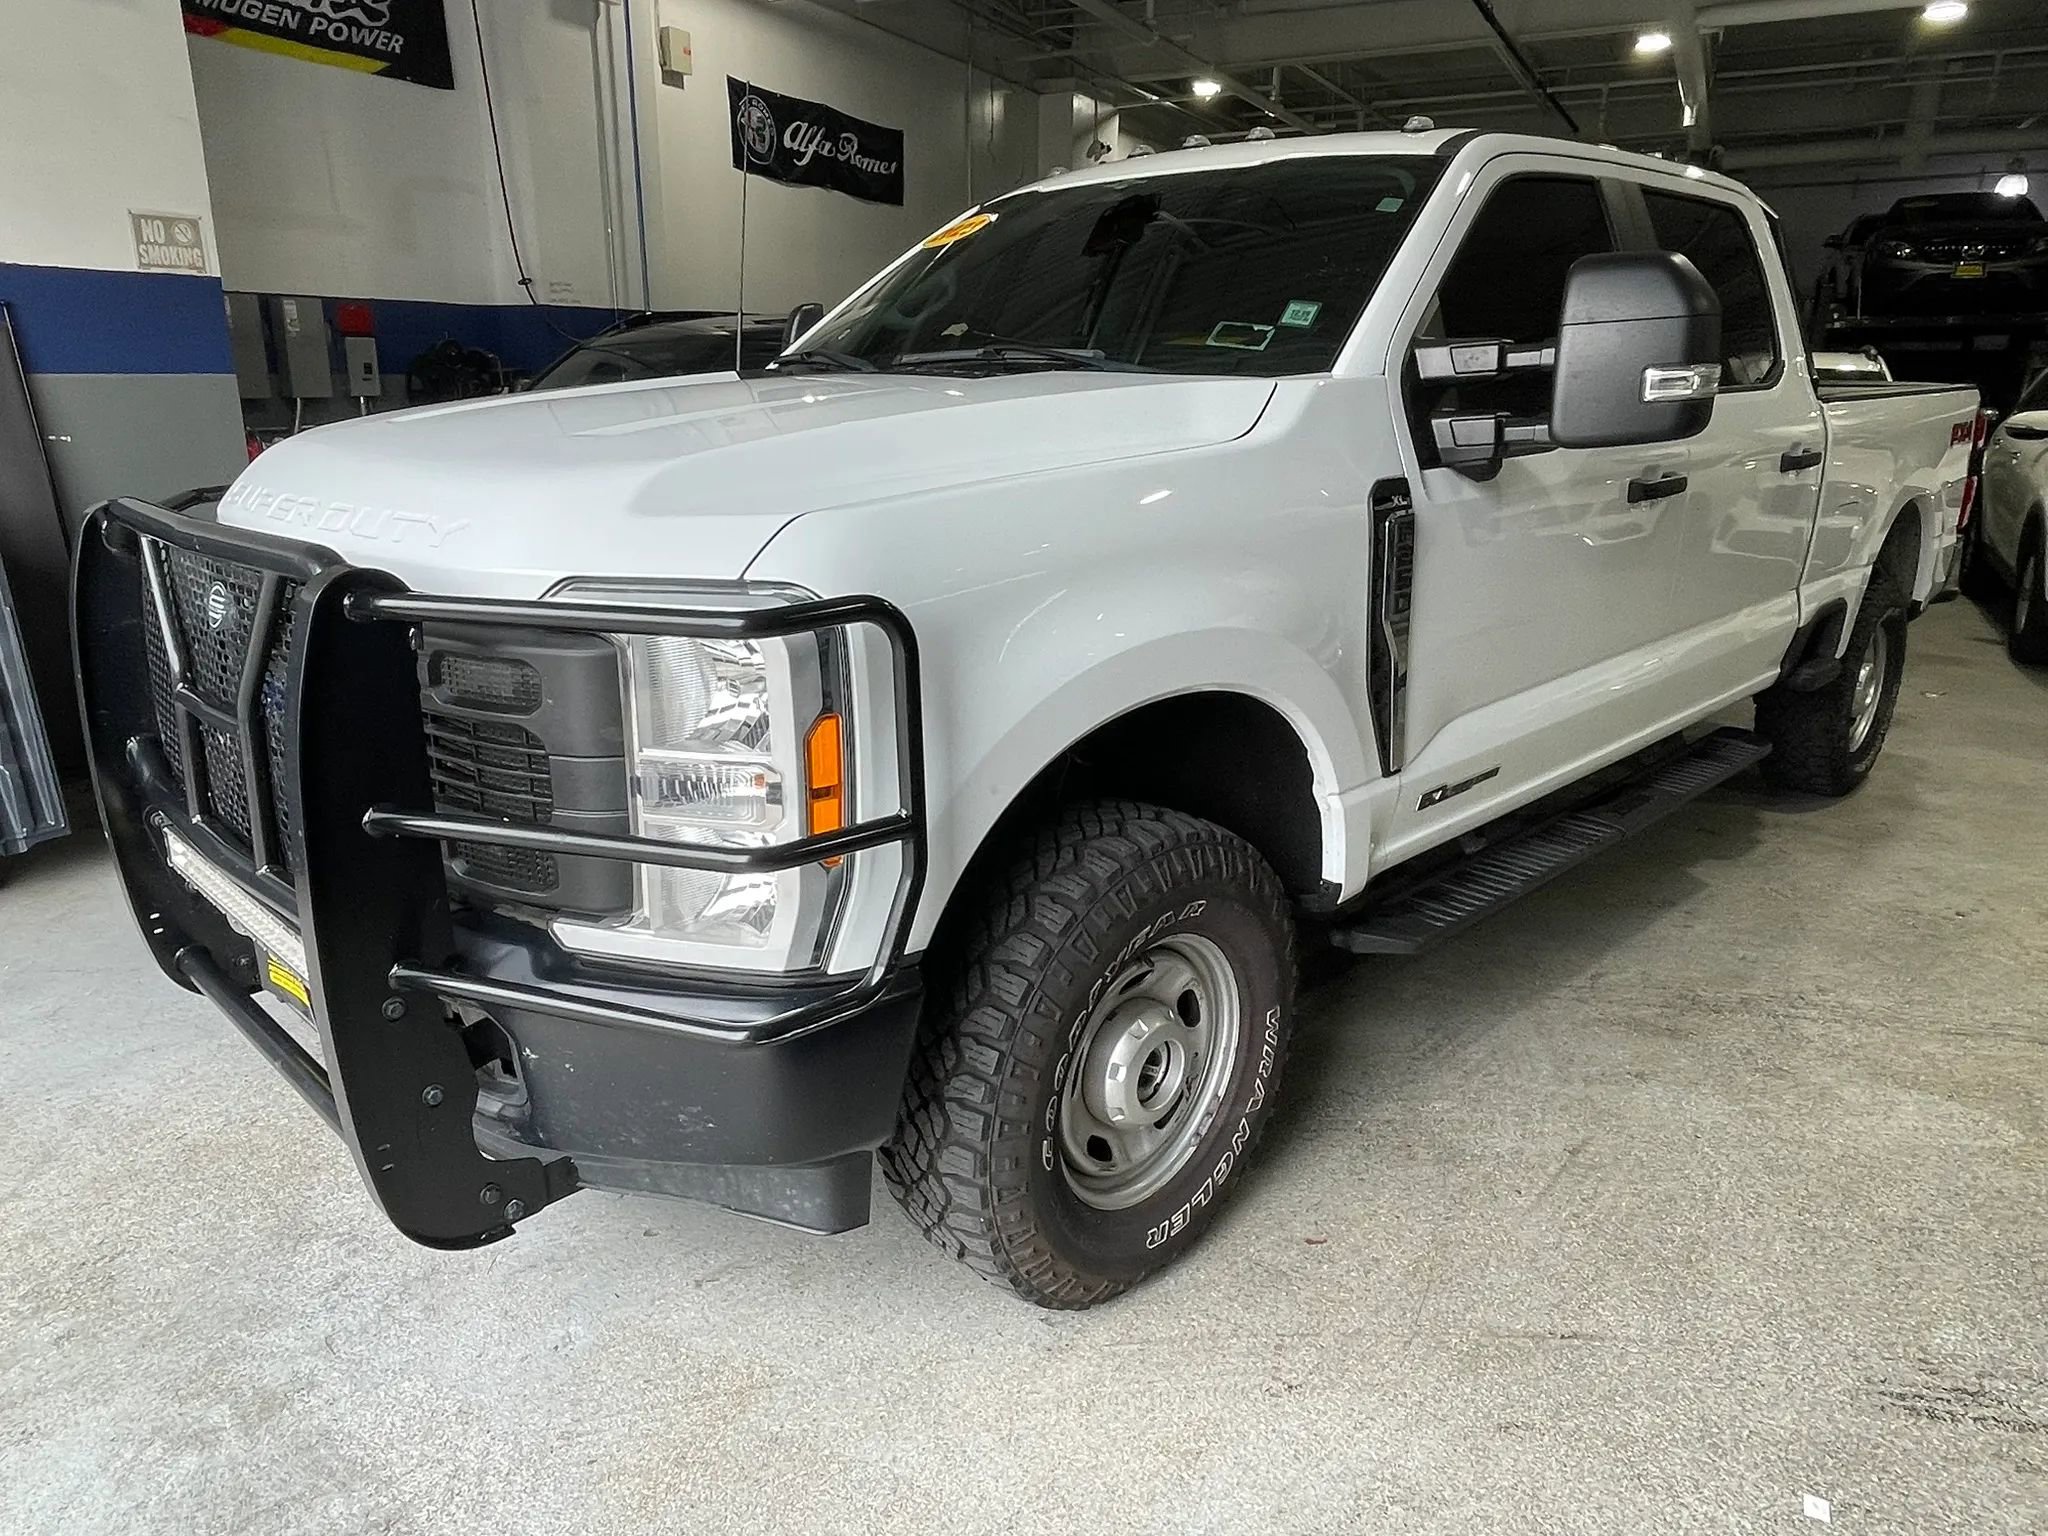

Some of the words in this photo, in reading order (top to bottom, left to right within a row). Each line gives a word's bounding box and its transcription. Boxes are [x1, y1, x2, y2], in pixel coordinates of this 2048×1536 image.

[308, 17, 405, 54] POWER
[783, 121, 836, 166] Alfa
[140, 218, 166, 244] NO
[139, 244, 204, 268] SMOKING
[227, 482, 319, 526] SUPER
[318, 502, 470, 548] DUTY
[1391, 494, 1408, 508] XL
[1145, 1005, 1281, 1249] WRANGLER
